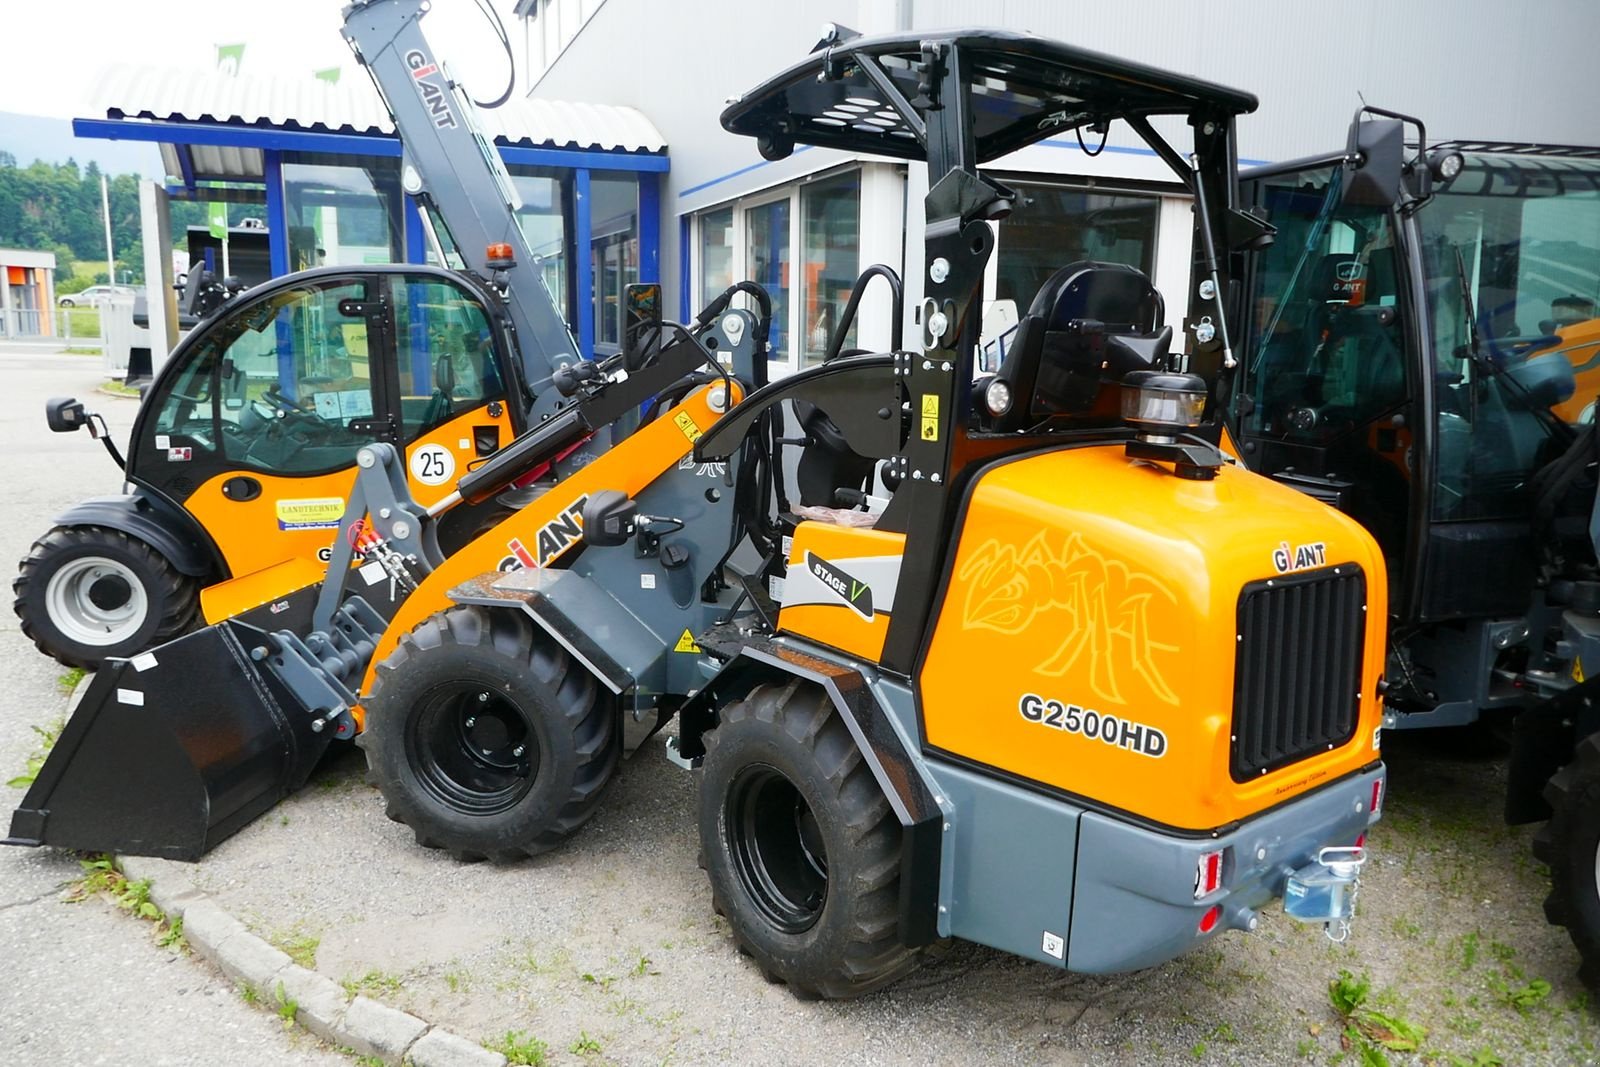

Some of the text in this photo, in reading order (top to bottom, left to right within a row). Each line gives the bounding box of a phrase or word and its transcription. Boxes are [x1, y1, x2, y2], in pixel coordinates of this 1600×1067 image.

[420, 452, 444, 477] 25
[281, 504, 340, 514] LANDTECHNIK
[814, 563, 847, 596] STAGE
[851, 580, 870, 602] V
[1020, 694, 1167, 758] G2500HD
